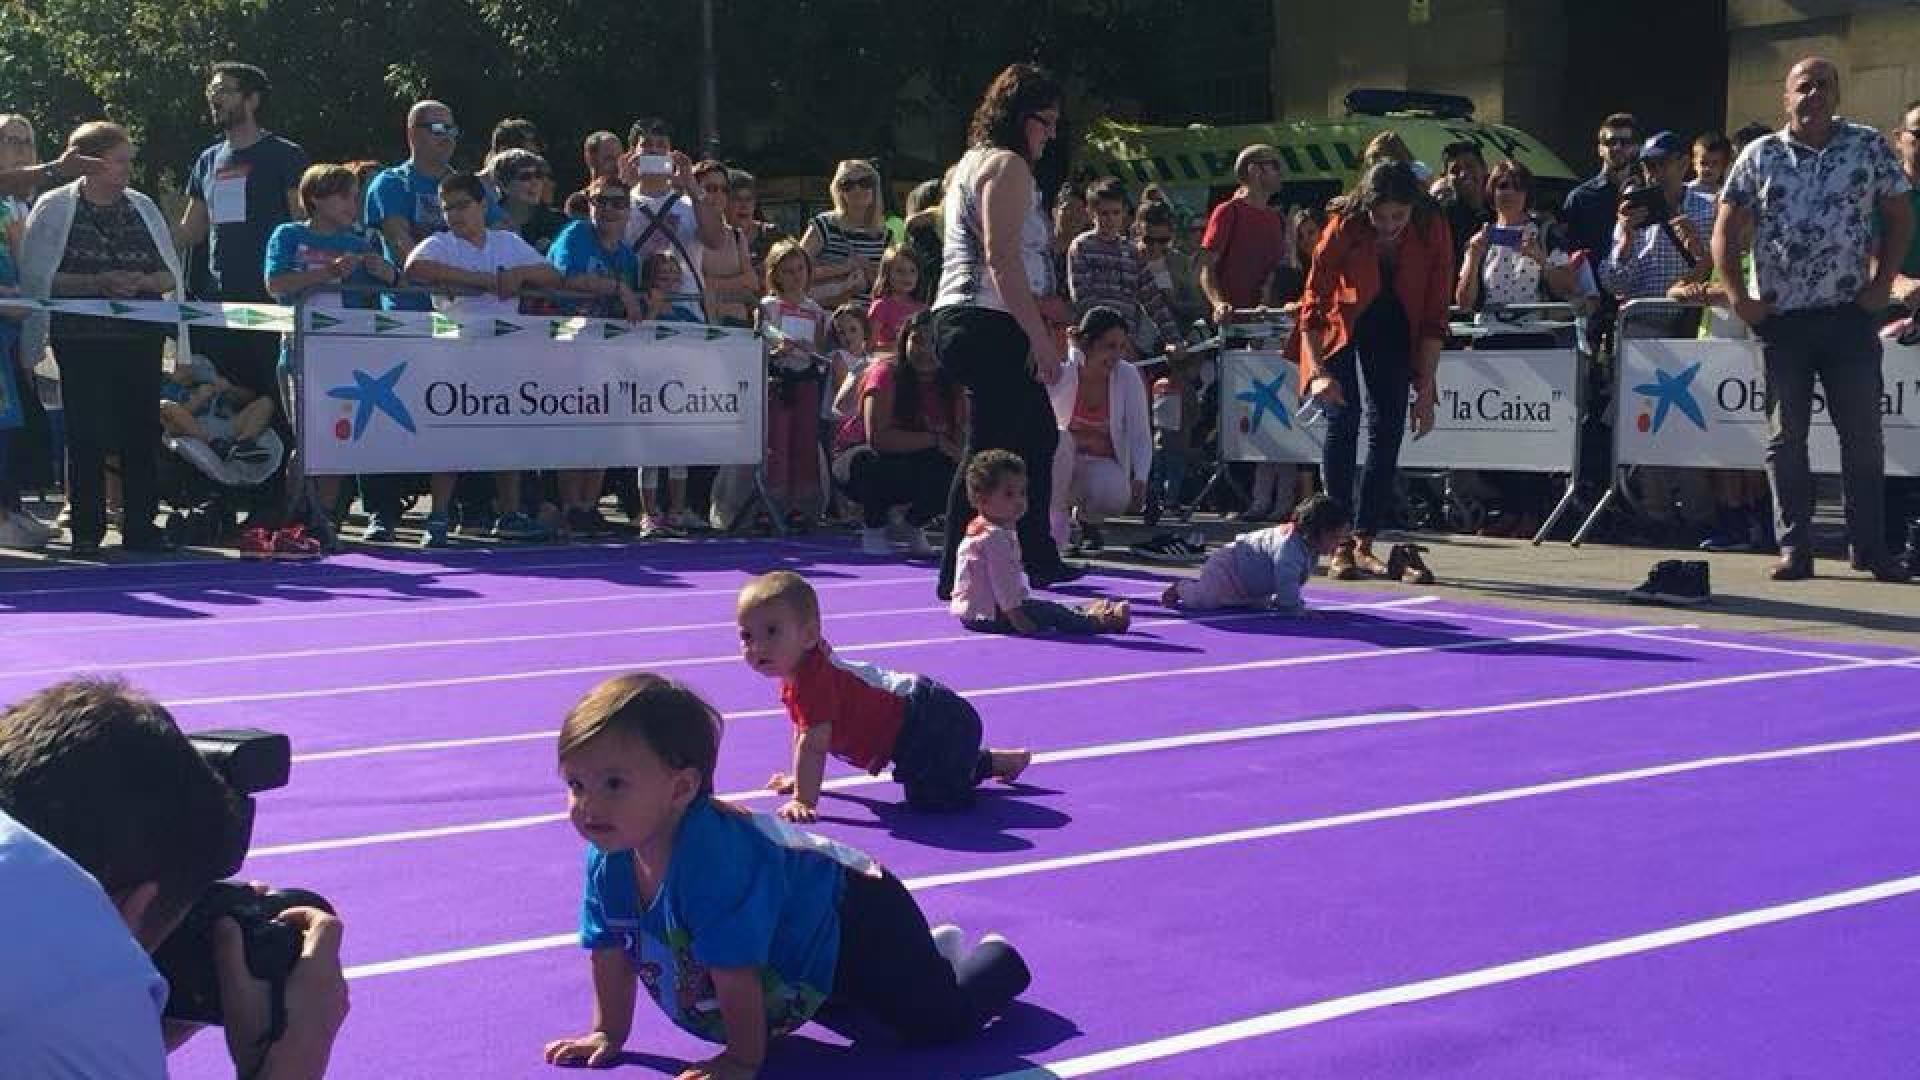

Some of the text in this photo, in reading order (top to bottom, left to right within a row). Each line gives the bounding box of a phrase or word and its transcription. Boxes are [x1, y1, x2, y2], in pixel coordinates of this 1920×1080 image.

[425, 381, 511, 416] Obra
[519, 381, 609, 416] Social
[1717, 377, 1767, 412] Ob
